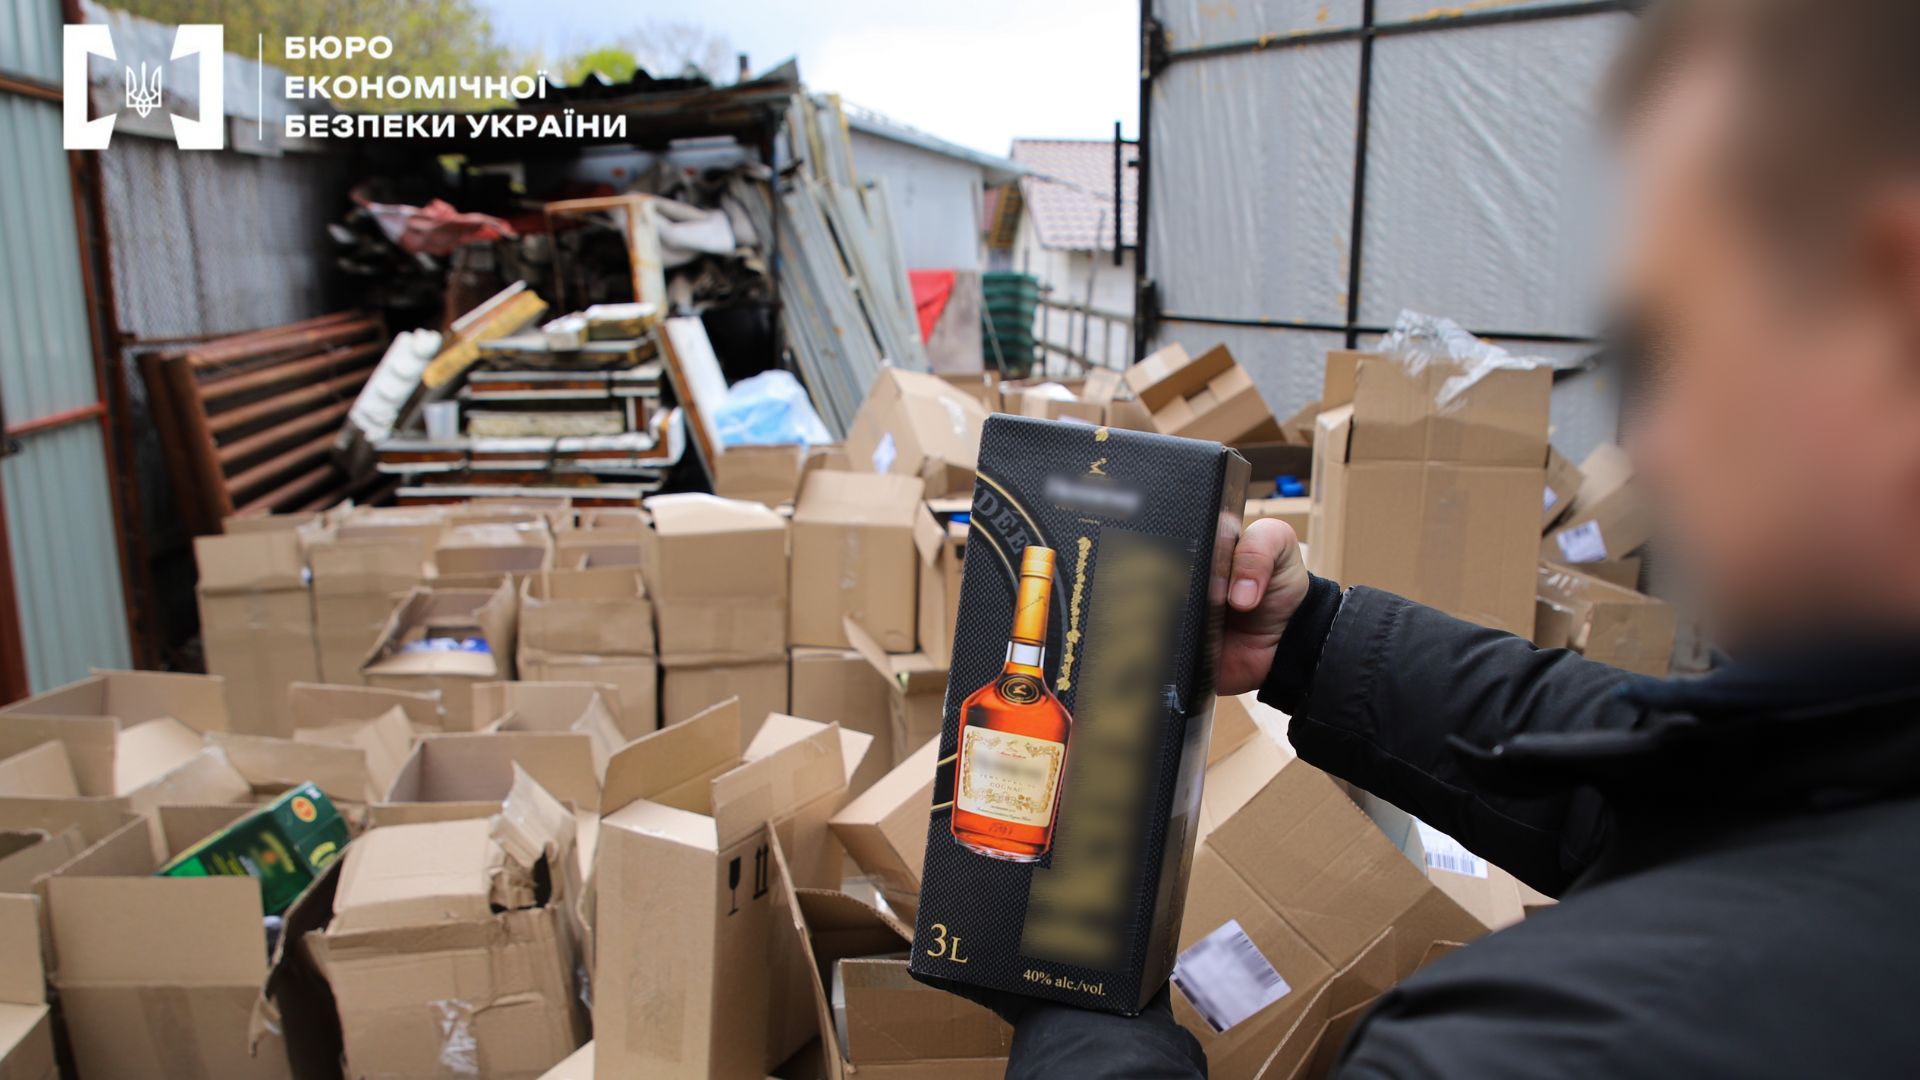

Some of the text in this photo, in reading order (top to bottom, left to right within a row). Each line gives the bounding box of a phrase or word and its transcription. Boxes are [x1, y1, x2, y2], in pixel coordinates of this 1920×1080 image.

[927, 923, 968, 964] 3L
[1023, 969, 1107, 996] 40% alc./vol.
